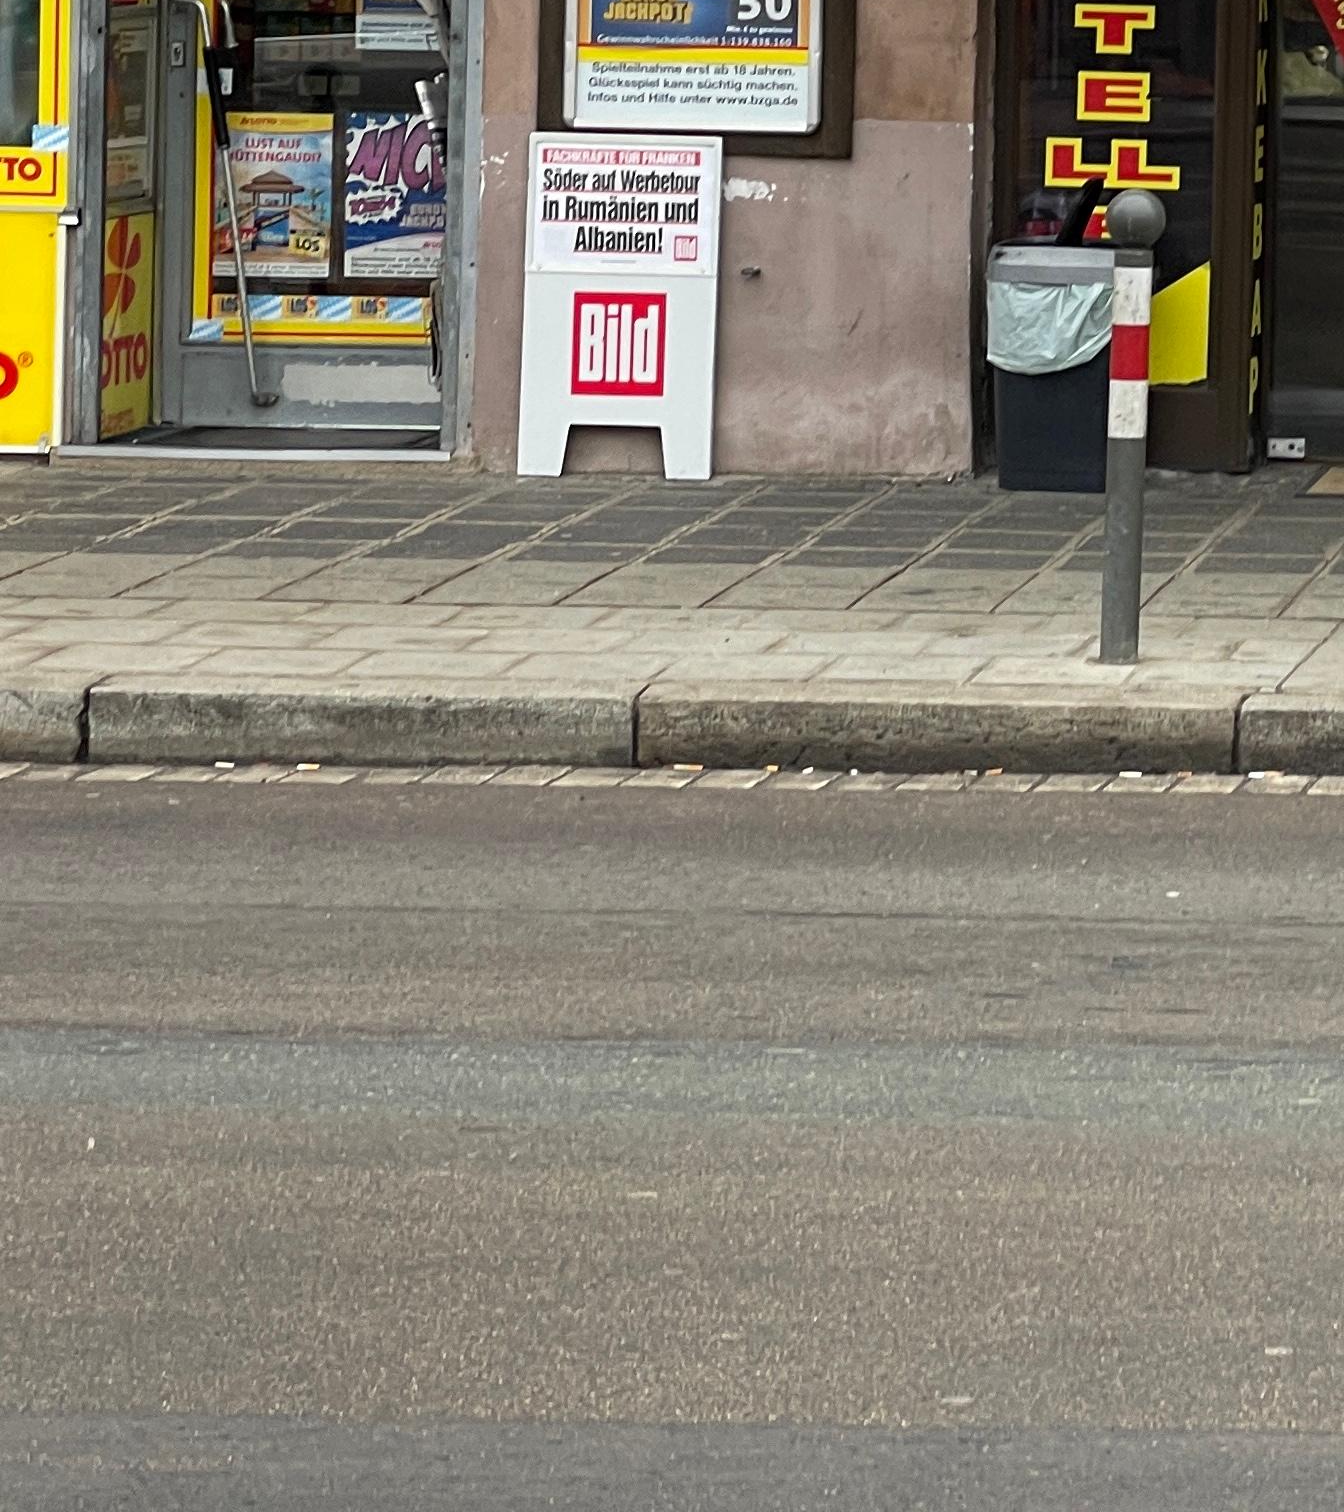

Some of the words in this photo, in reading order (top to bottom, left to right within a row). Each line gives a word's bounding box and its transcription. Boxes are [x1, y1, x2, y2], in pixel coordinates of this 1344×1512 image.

[1044, 3, 1181, 240] TELL
[543, 168, 588, 191] Söder
[592, 170, 617, 191] auf
[620, 170, 701, 193] Werbetour
[542, 195, 560, 221] in
[564, 196, 659, 222] Rumänien
[664, 198, 699, 224] und
[573, 226, 663, 253] Albanien!
[101, 332, 148, 389] OTTO
[578, 303, 660, 384] Bild
